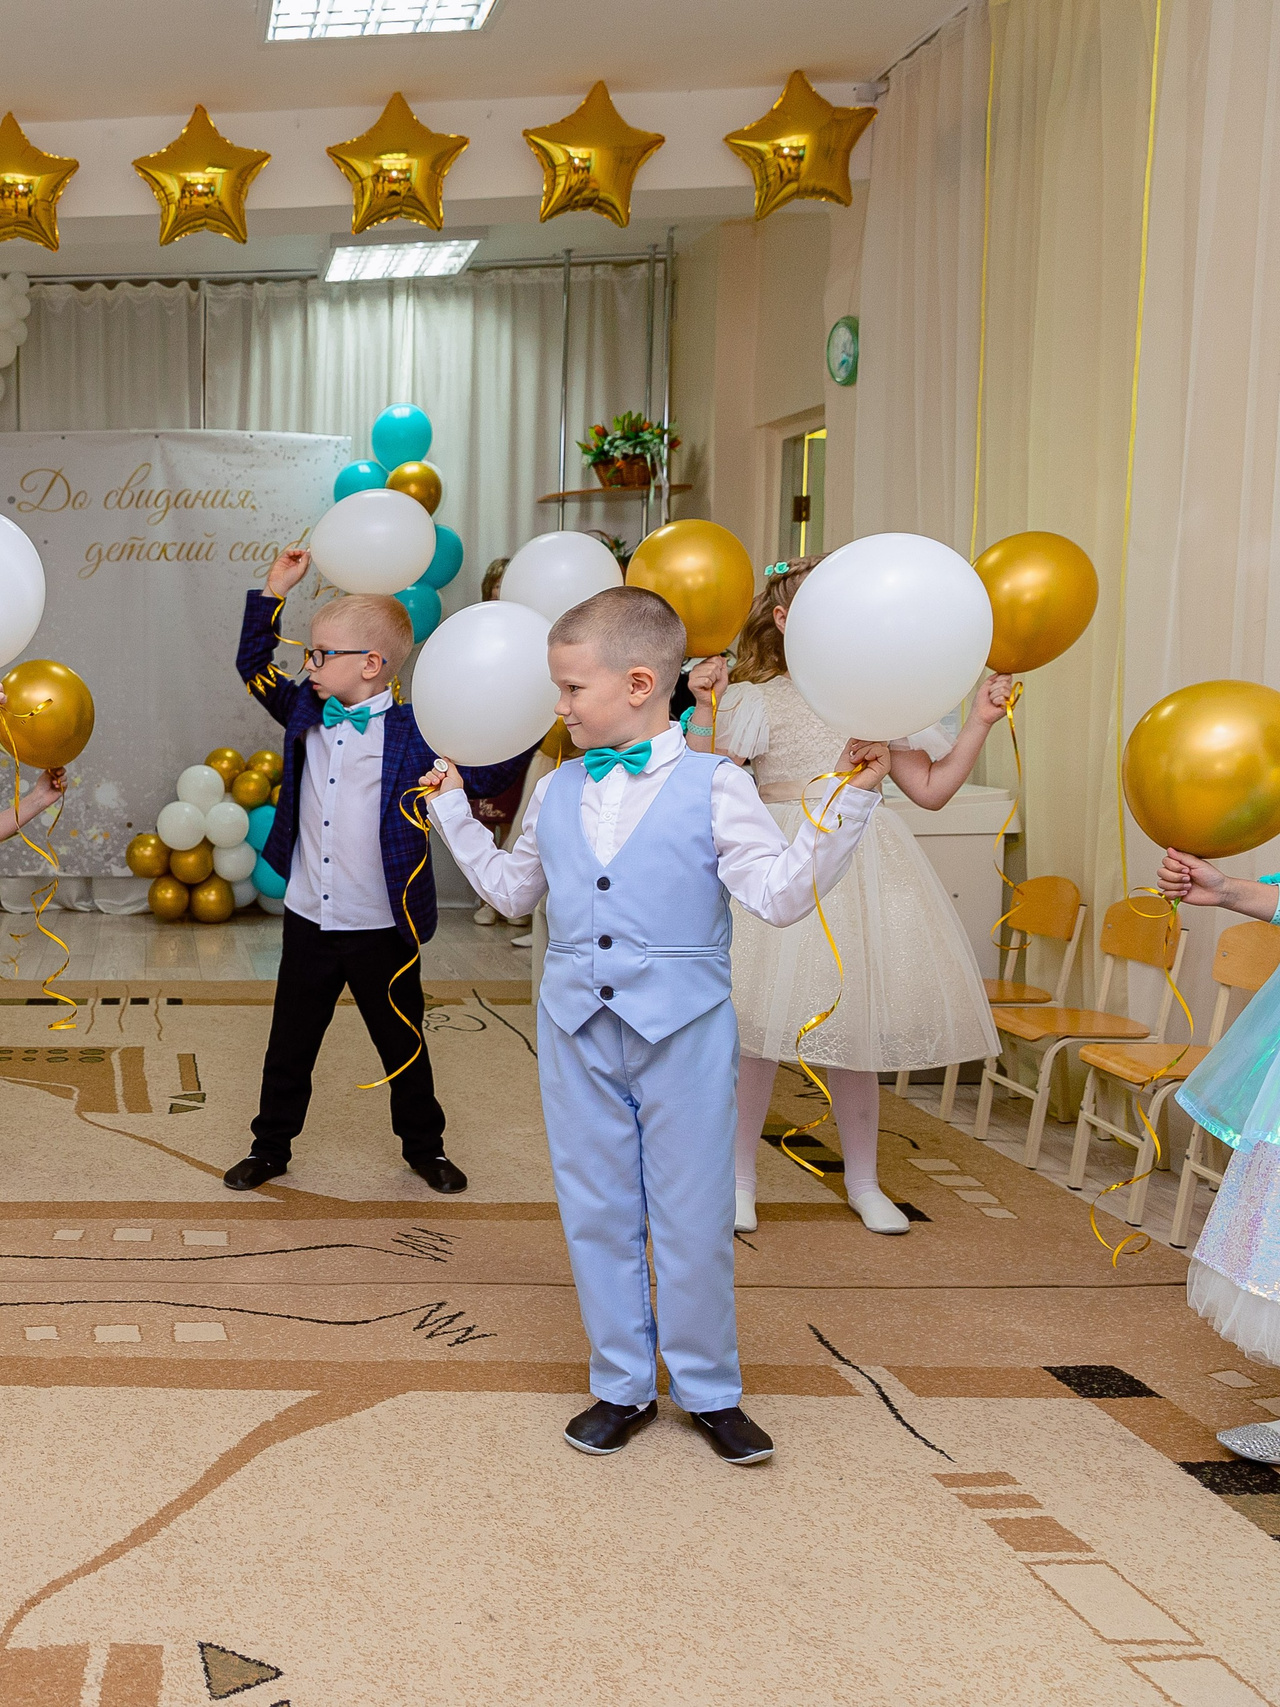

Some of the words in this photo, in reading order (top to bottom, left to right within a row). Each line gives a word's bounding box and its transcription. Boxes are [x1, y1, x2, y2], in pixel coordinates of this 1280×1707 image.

[17, 466, 88, 513] До
[104, 462, 258, 526] свидания,
[78, 531, 217, 580] детский
